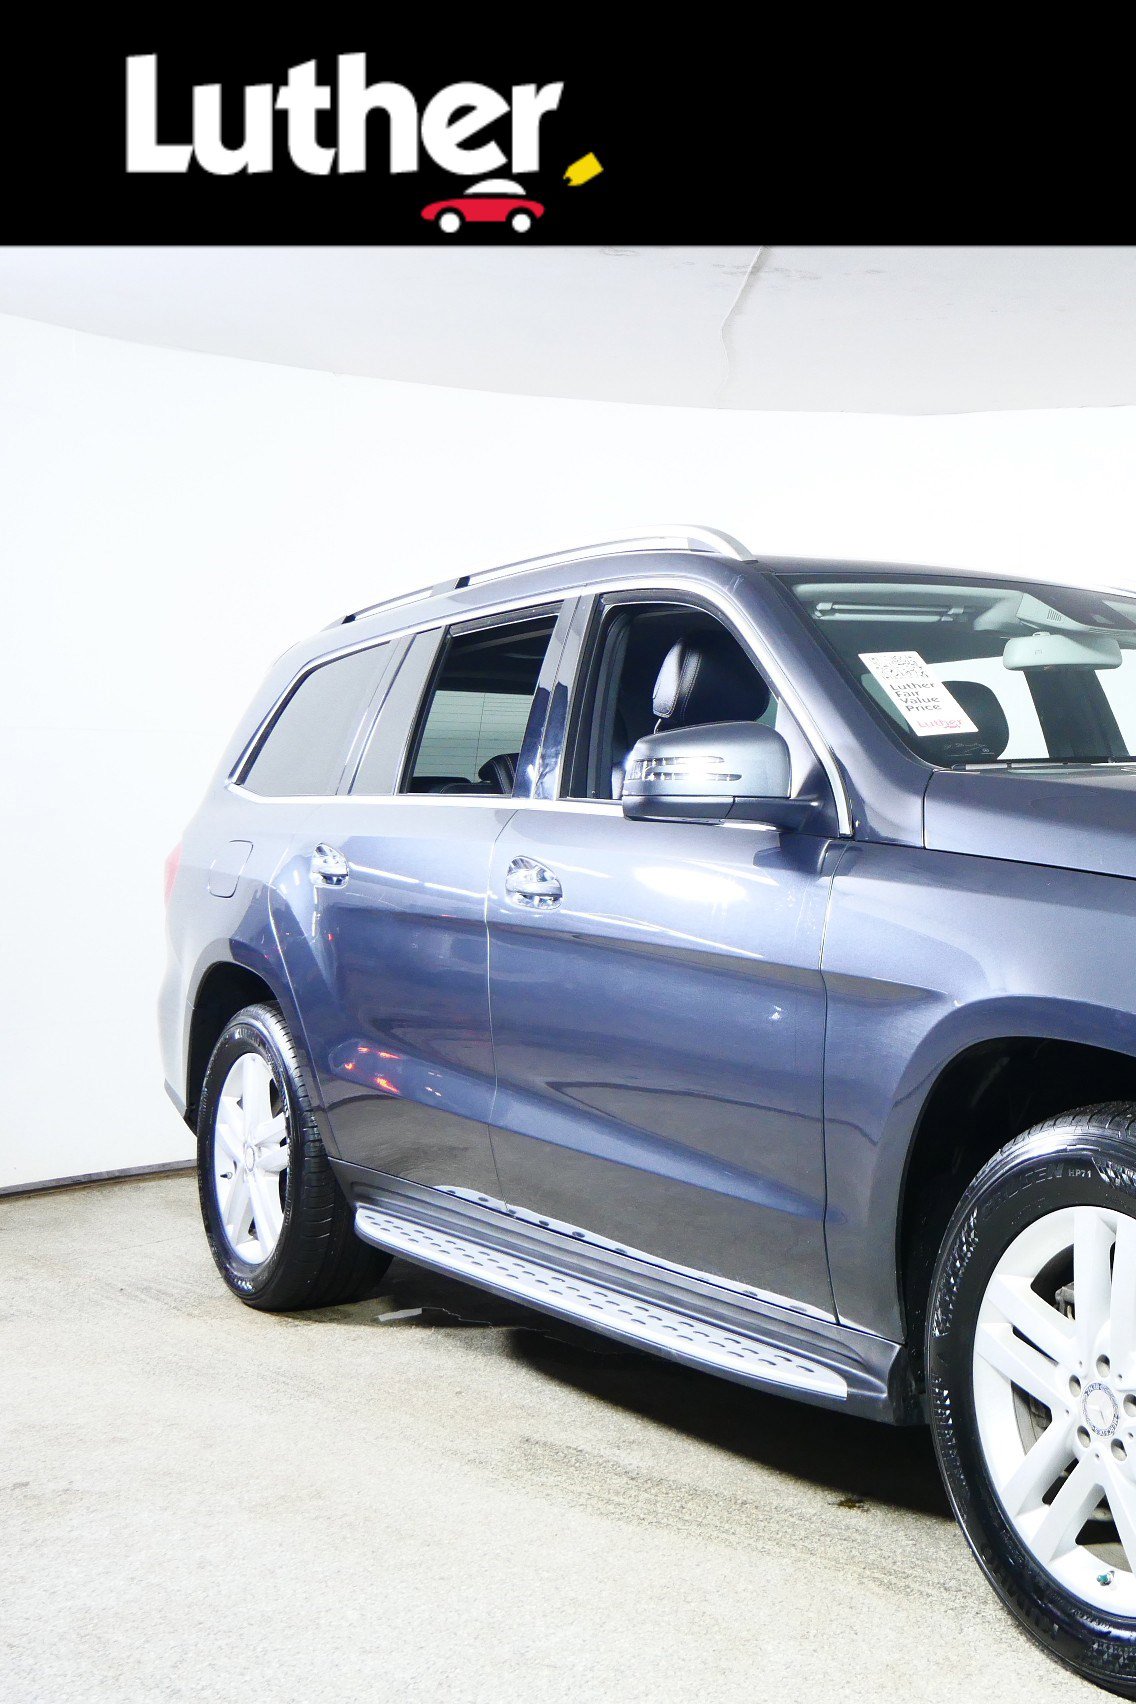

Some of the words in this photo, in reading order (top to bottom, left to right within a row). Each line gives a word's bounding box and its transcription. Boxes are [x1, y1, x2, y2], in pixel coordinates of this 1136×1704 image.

[889, 682, 935, 691] Luther
[894, 690, 920, 698] Fair
[900, 696, 941, 704] Value
[905, 704, 942, 712] Price
[1068, 1168, 1092, 1178] HP71
